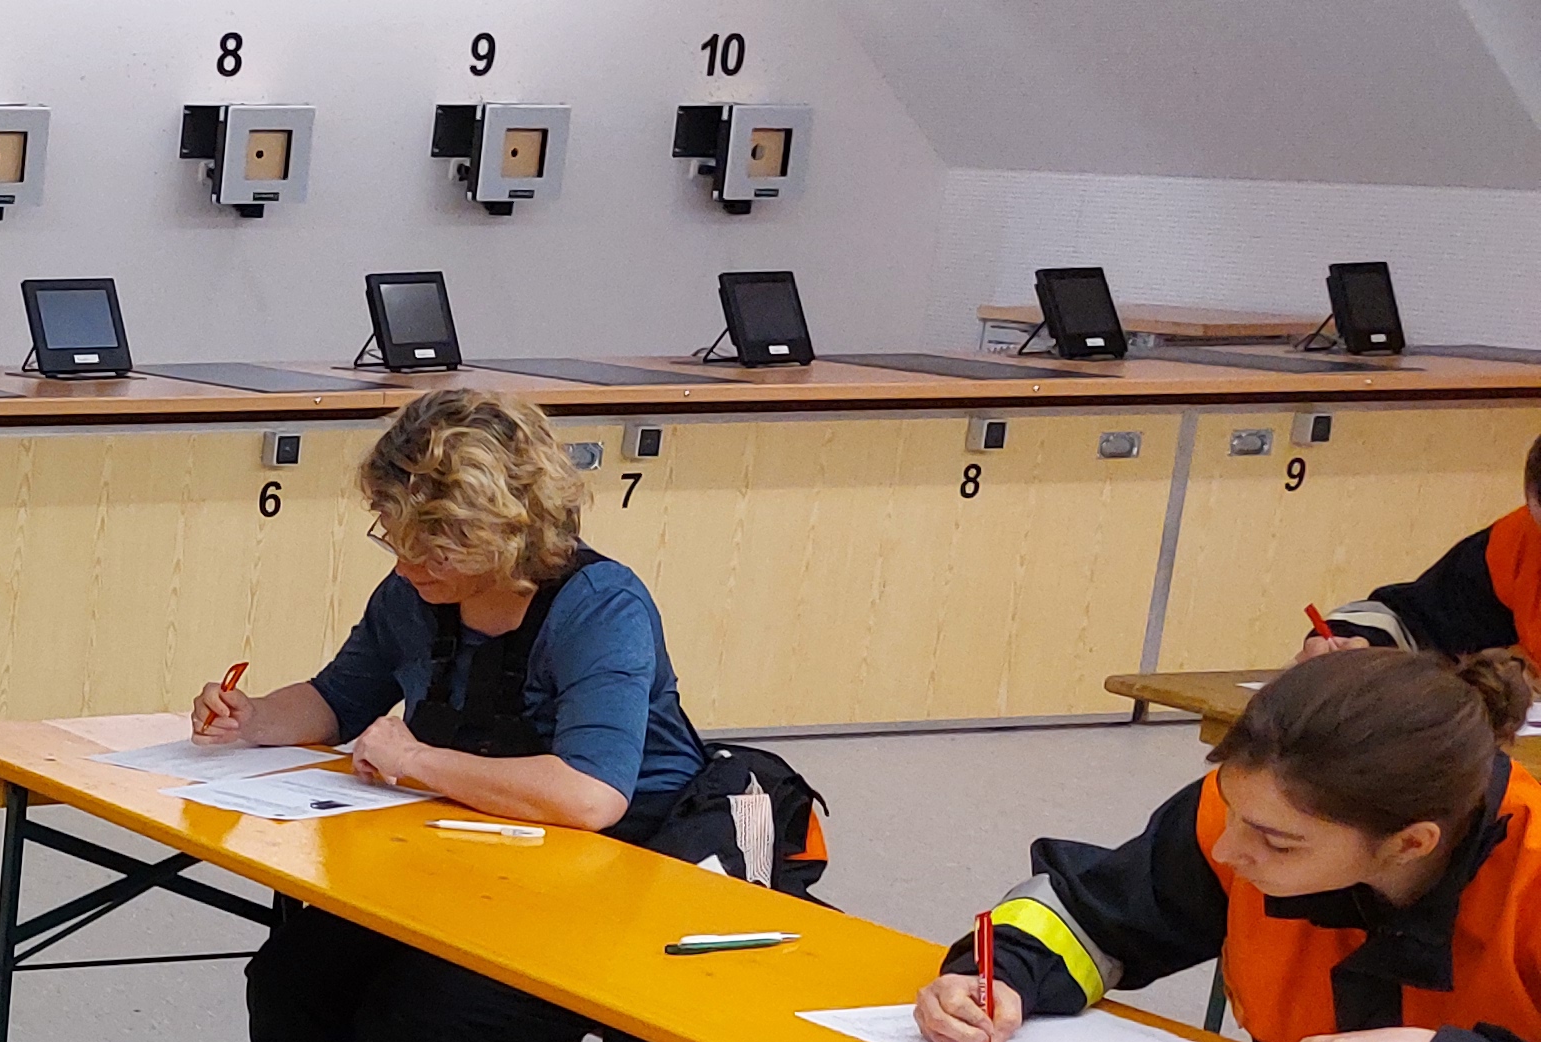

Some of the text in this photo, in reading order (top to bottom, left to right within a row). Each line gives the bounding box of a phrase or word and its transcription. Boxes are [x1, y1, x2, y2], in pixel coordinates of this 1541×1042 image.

[216, 32, 243, 78] 8
[469, 32, 496, 77] 9
[700, 32, 746, 77] 10
[620, 472, 643, 509] 7
[960, 463, 982, 499] 8
[1284, 457, 1306, 492] 9
[259, 481, 282, 518] 6
